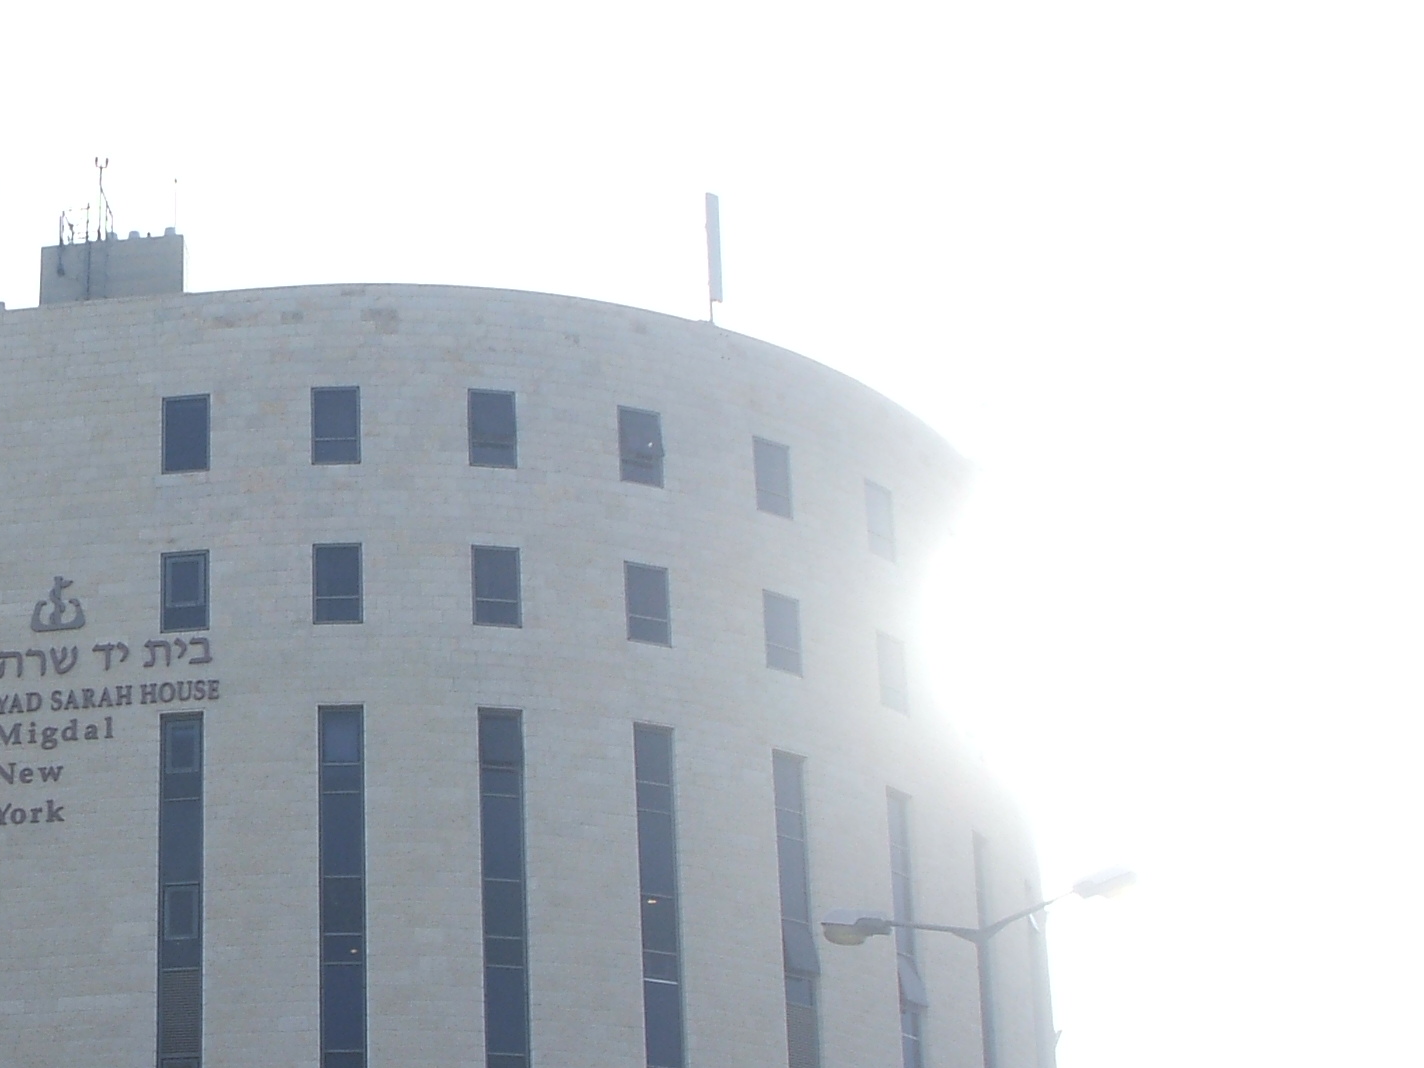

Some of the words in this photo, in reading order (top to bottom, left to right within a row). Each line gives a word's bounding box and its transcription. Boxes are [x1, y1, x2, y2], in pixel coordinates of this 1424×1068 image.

[92, 641, 130, 671] יד
[143, 637, 213, 669] בית
[50, 684, 133, 711] SARAH
[140, 679, 220, 705] HOUSE
